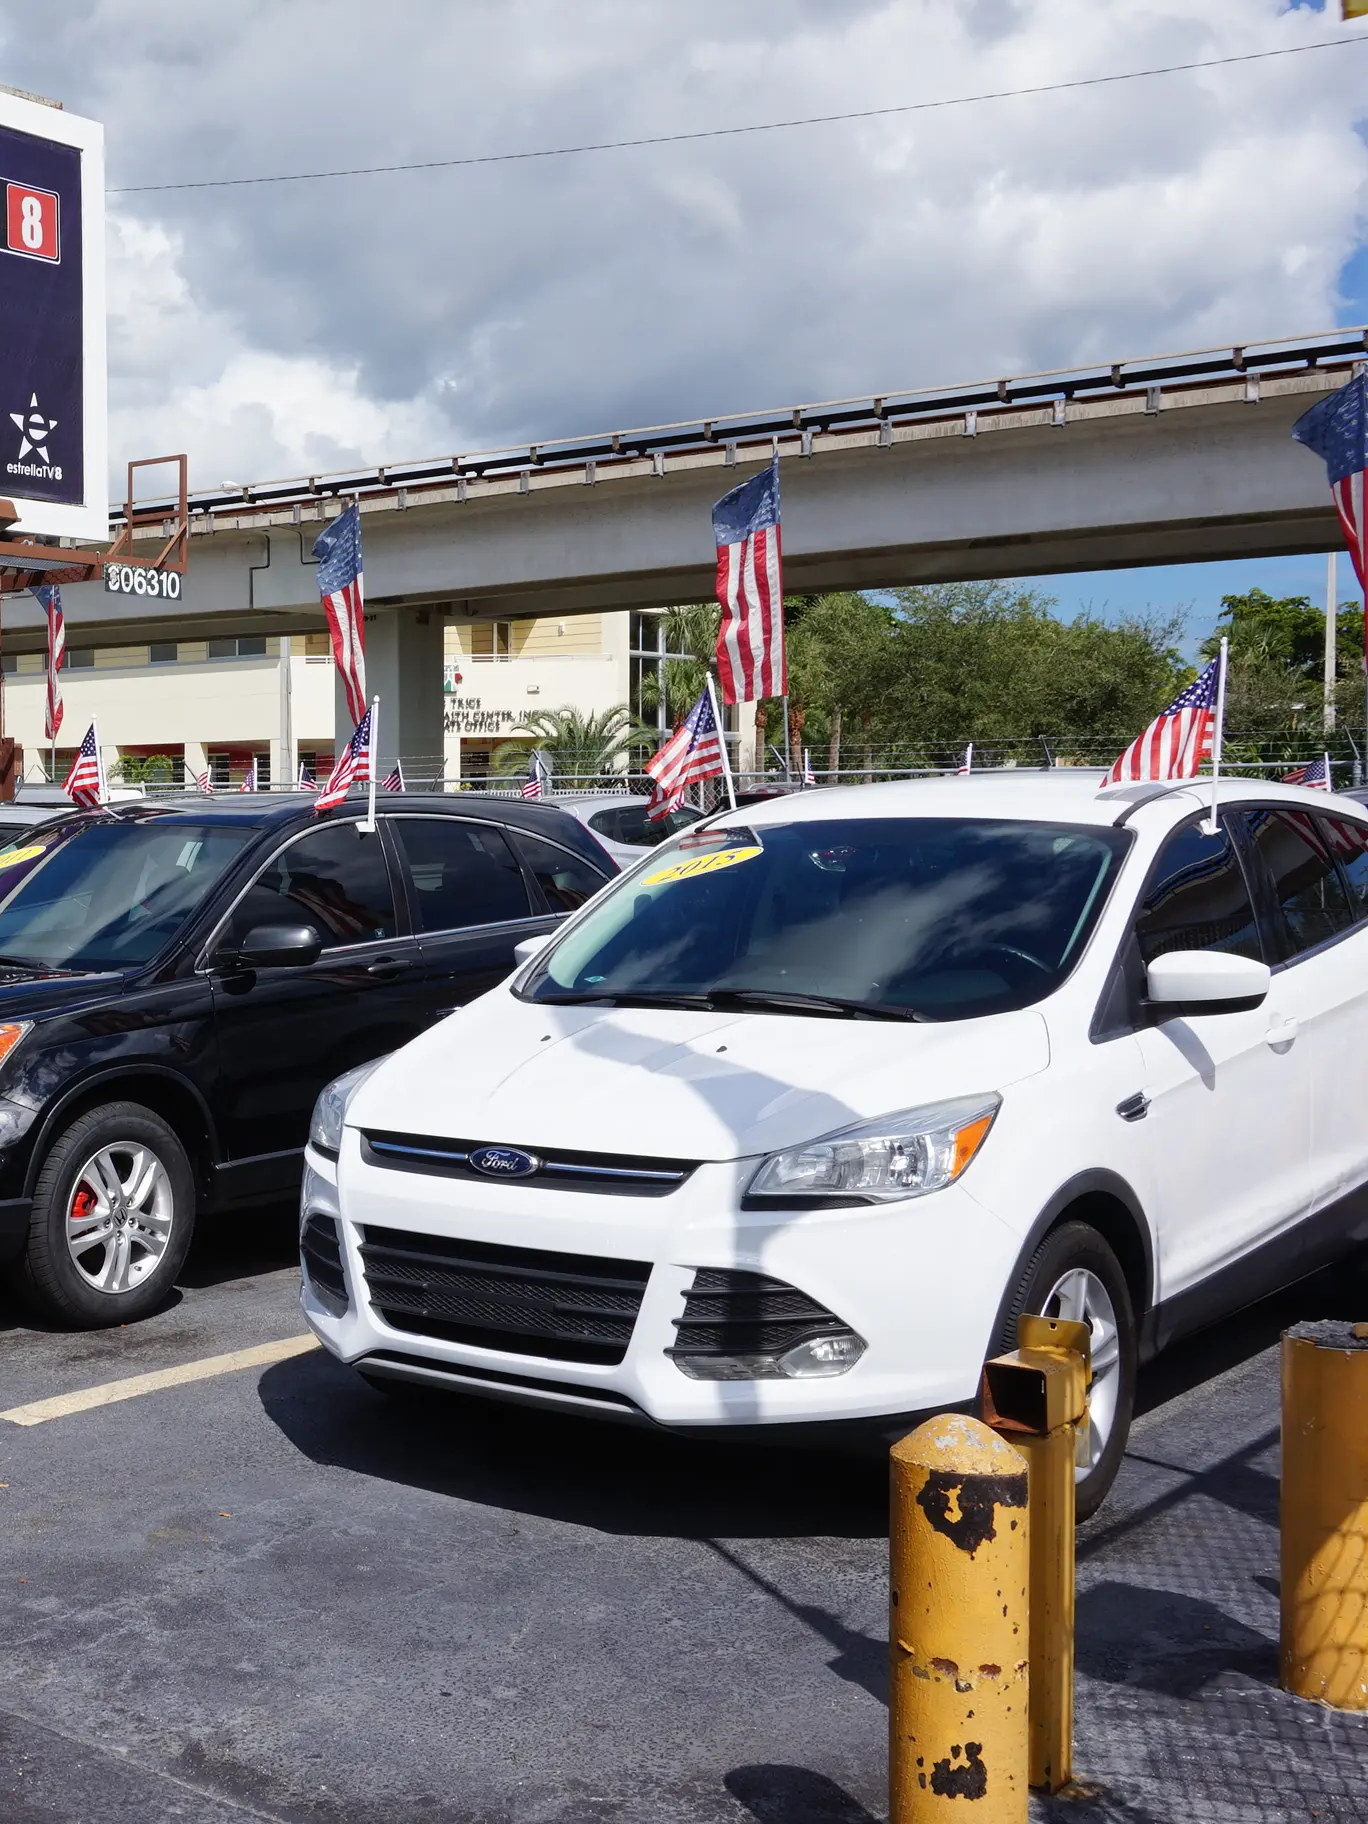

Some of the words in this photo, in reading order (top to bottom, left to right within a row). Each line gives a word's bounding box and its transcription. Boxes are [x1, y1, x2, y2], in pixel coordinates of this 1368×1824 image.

[20, 195, 44, 250] 8
[656, 849, 744, 882] 2015
[481, 1150, 520, 1171] Ford
